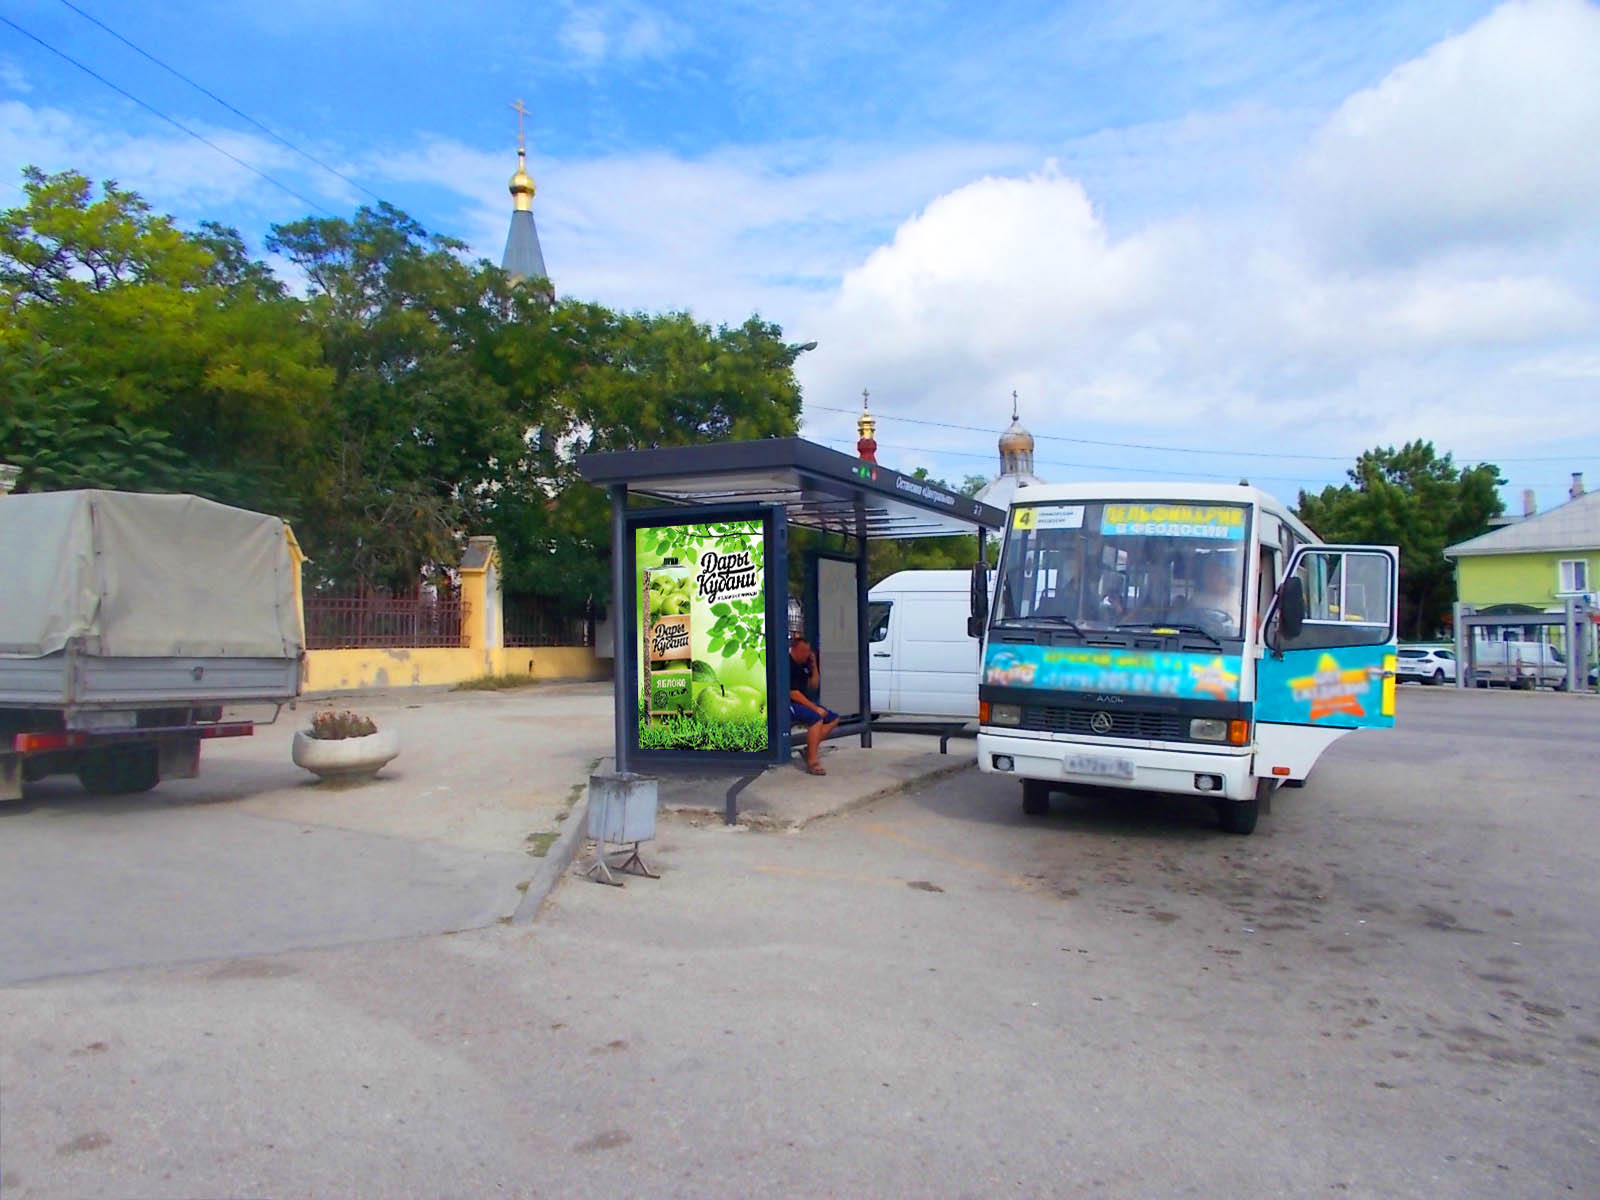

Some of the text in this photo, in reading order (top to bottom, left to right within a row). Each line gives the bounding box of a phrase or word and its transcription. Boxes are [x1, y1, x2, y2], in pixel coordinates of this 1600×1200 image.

[1019, 511, 1031, 526] 4
[1130, 522, 1228, 537] ФЕОДОСИИ
[701, 551, 752, 576] Дары
[697, 572, 756, 604] Кубани
[655, 623, 686, 638] Дары
[652, 636, 689, 657] Кубани
[656, 678, 686, 689] ЯБЛОКО
